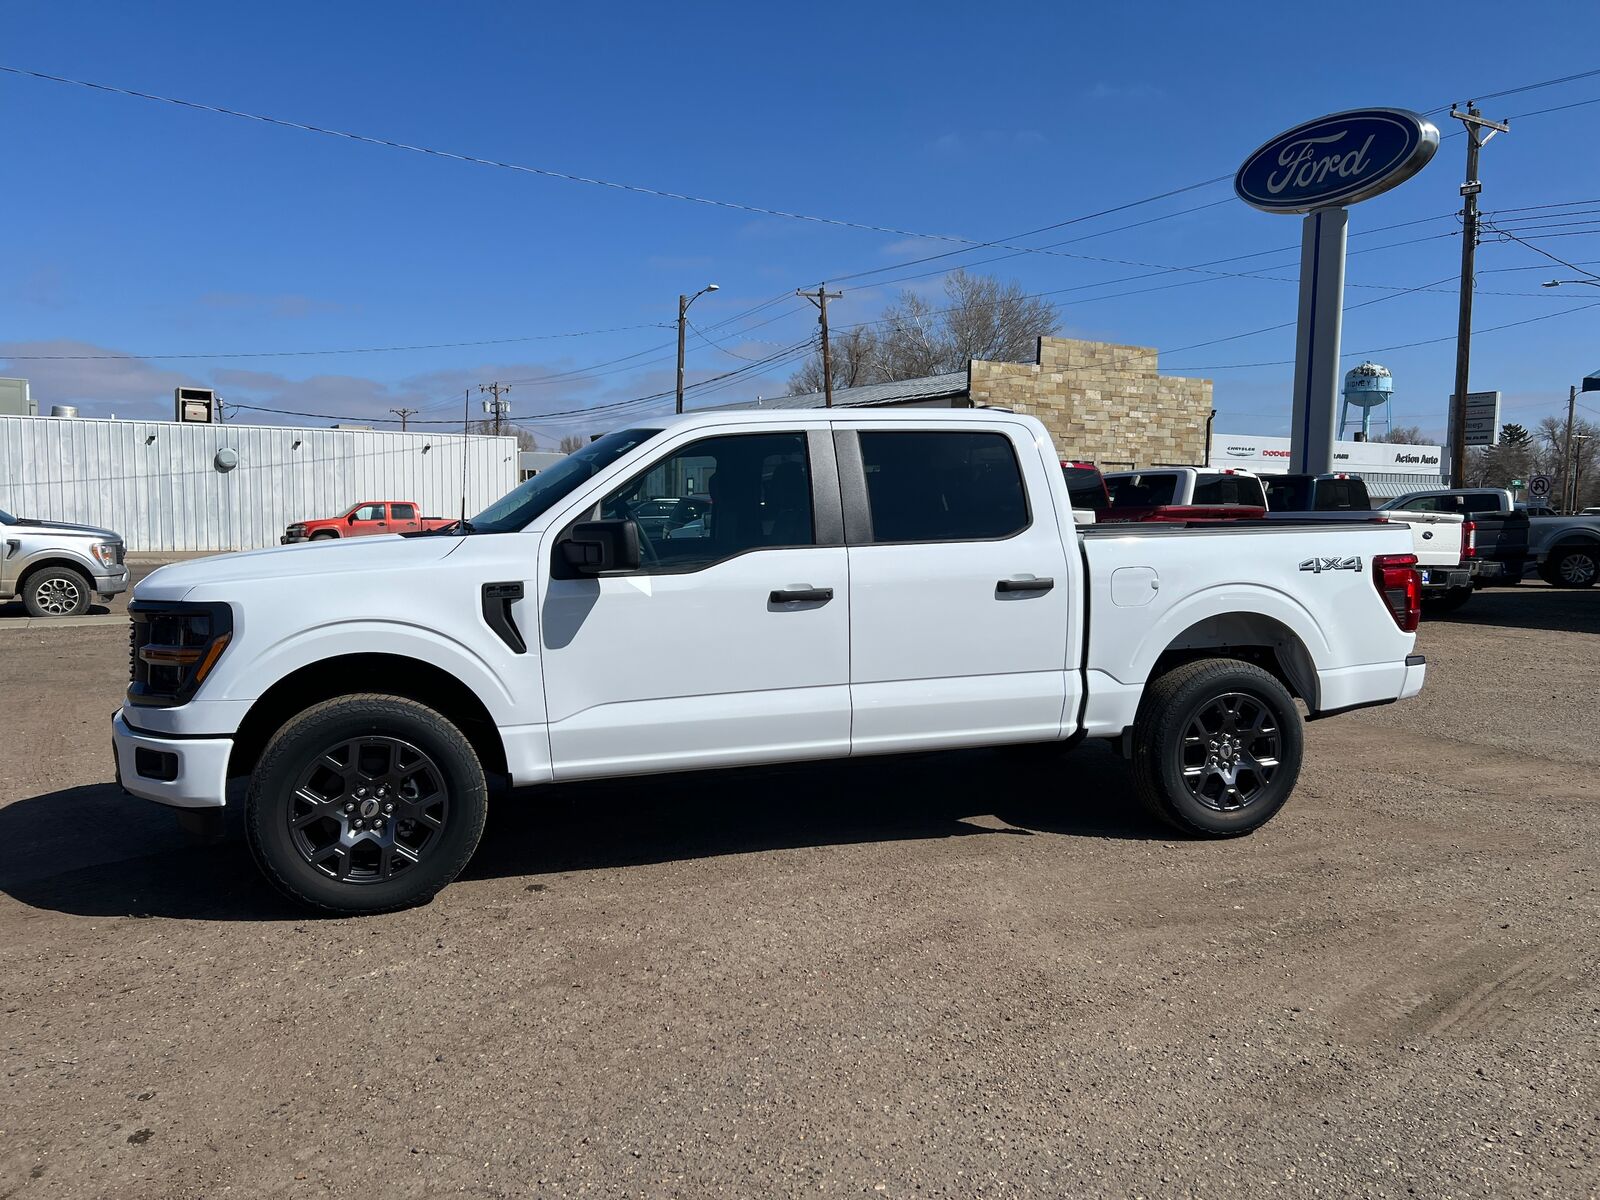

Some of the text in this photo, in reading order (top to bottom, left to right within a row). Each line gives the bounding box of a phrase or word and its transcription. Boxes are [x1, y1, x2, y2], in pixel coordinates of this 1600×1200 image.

[1267, 130, 1376, 193] Ford
[1395, 453, 1438, 464] Action Auto
